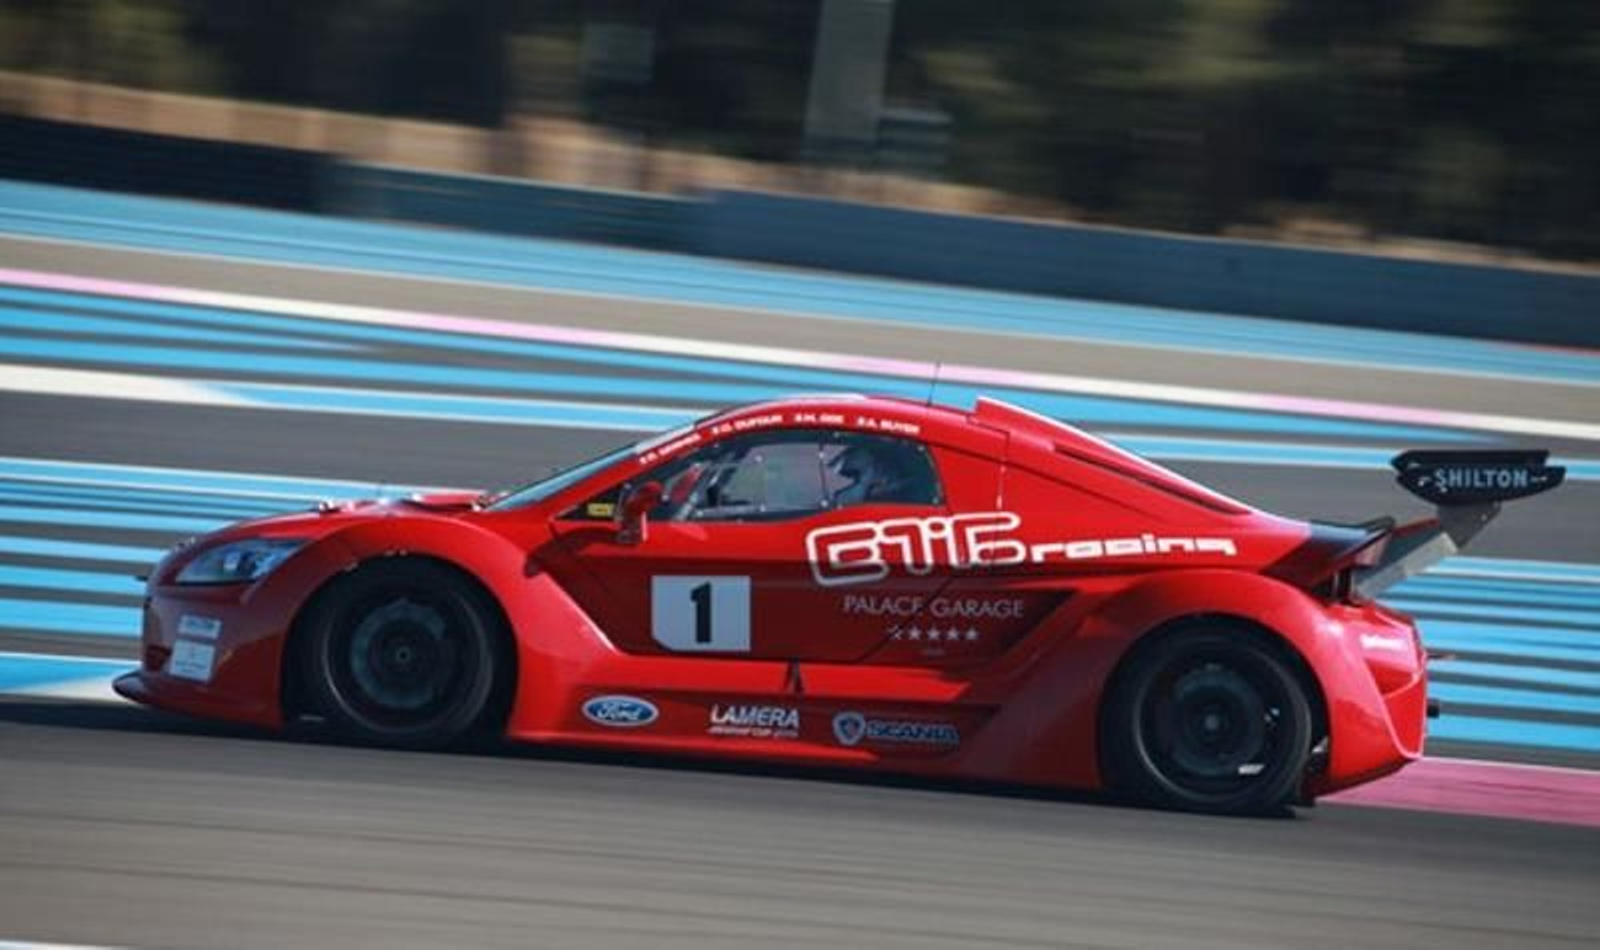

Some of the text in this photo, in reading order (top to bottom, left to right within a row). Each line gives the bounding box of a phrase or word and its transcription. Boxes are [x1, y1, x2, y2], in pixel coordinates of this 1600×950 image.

[1434, 467, 1529, 489] SHILTON
[690, 580, 712, 644] 1
[929, 598, 1024, 619] GARAGE
[596, 700, 644, 721] Ford
[709, 703, 800, 728] LAMERA
[866, 720, 961, 745] SCANIA
